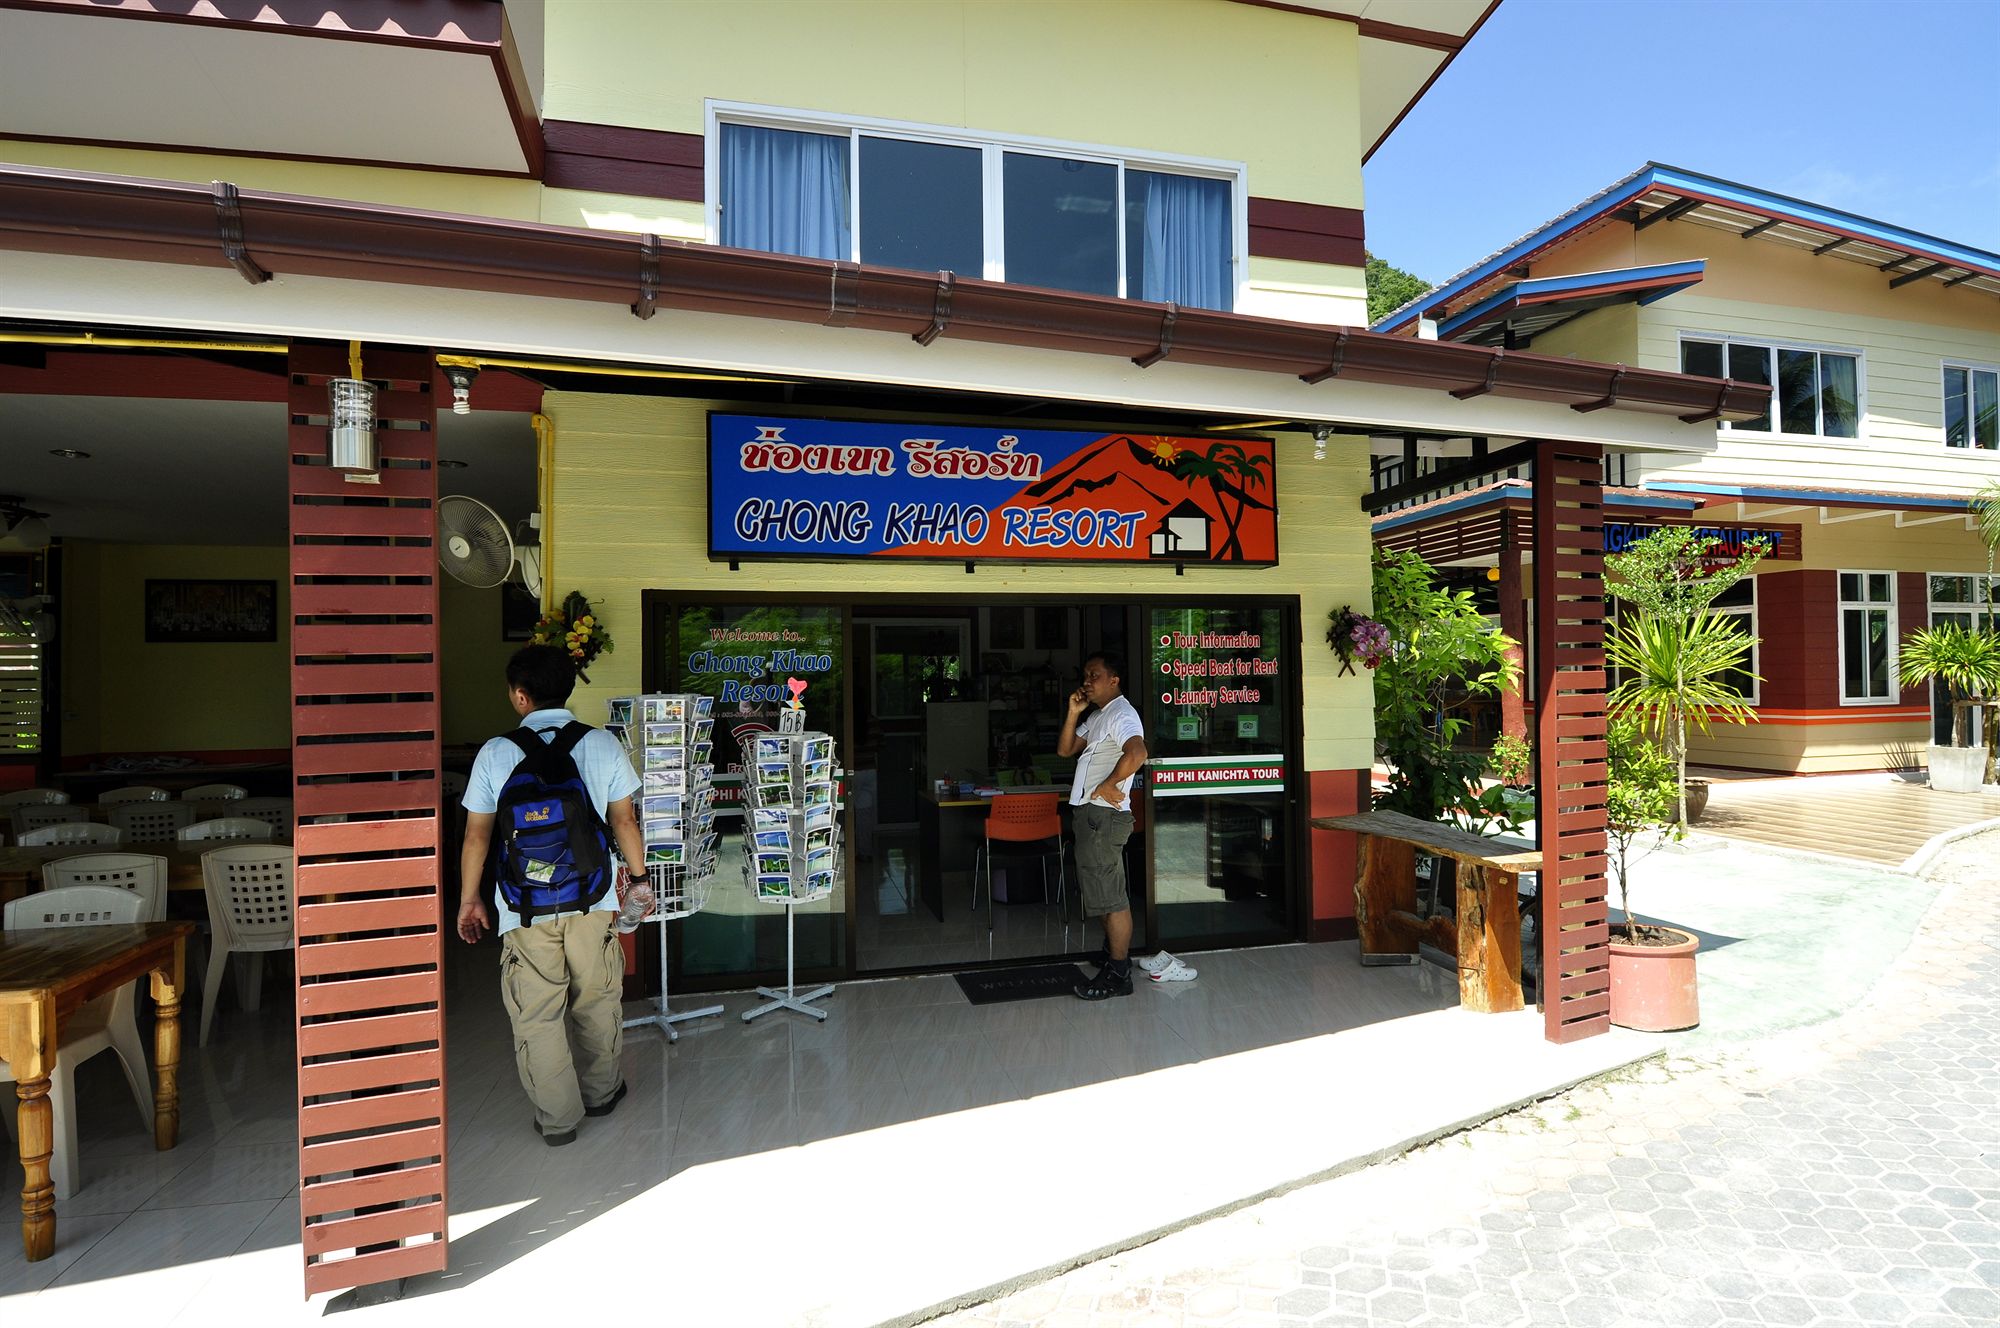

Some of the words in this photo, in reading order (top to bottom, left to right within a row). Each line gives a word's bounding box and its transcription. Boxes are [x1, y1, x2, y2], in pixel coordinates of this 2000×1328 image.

[741, 426, 896, 477] ช่องเขา
[900, 435, 1042, 481] รีสอร์ท
[734, 497, 873, 544] CHONG
[883, 502, 989, 545] KHAO
[1002, 505, 1146, 548] RESORT
[709, 628, 780, 642] Welcome
[1173, 631, 1198, 648] Tour
[1200, 631, 1260, 648] Information
[688, 650, 765, 678] Chong
[770, 648, 832, 672] Khao
[1173, 659, 1207, 680] Speed
[1209, 659, 1234, 676] Boat
[1236, 658, 1251, 675] for
[1253, 657, 1278, 675] Rent
[720, 679, 805, 703] Resor
[1174, 686, 1218, 708] Laundry
[1220, 686, 1260, 703] Service
[1156, 772, 1174, 783] PHI
[1177, 771, 1195, 782] PHI
[1197, 769, 1250, 781] KANICHTA
[1252, 768, 1280, 779] TOUR
